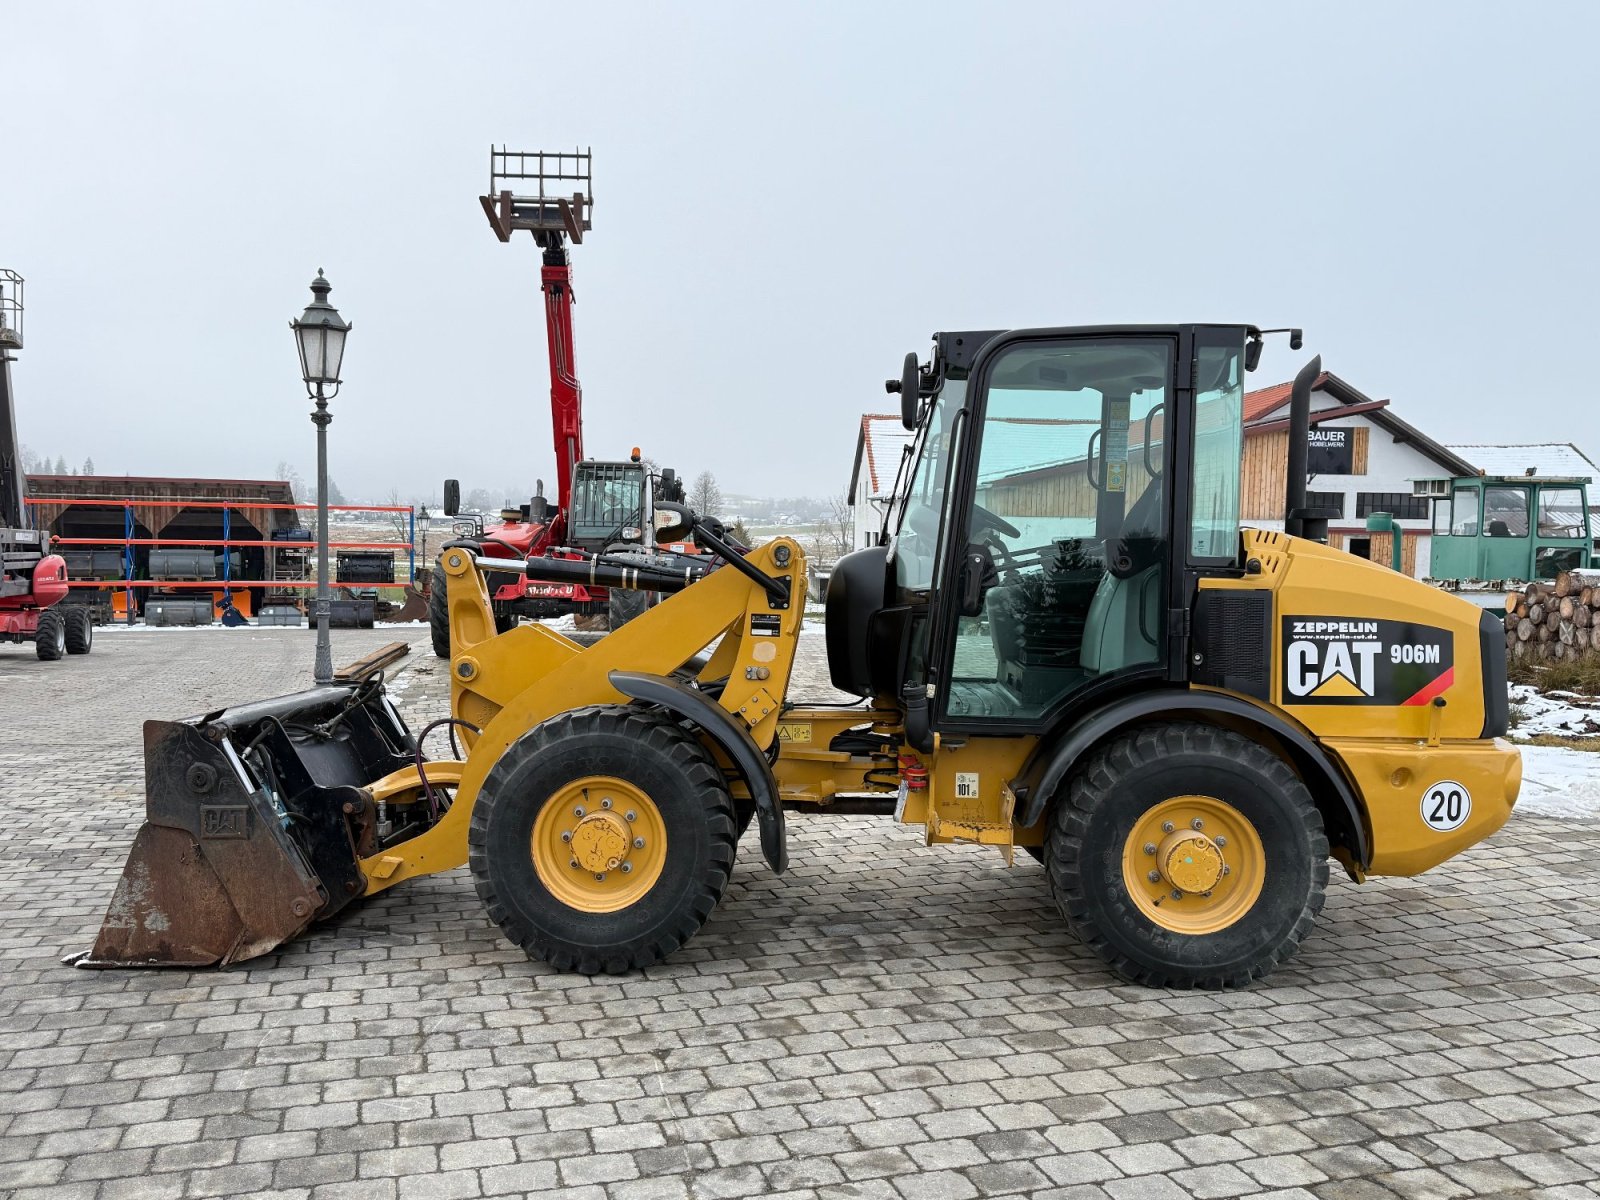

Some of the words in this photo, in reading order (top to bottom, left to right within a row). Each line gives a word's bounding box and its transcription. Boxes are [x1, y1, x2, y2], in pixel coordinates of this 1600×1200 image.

[1307, 431, 1345, 441] BAUER
[1293, 622, 1377, 632] ZEPPELIN
[1293, 633, 1377, 641] www.zeppelin-cat.de
[1390, 644, 1440, 664] 906M
[1287, 640, 1382, 696] CAT
[957, 784, 970, 796] 101
[1429, 790, 1462, 822] 20
[205, 810, 244, 834] CAT
